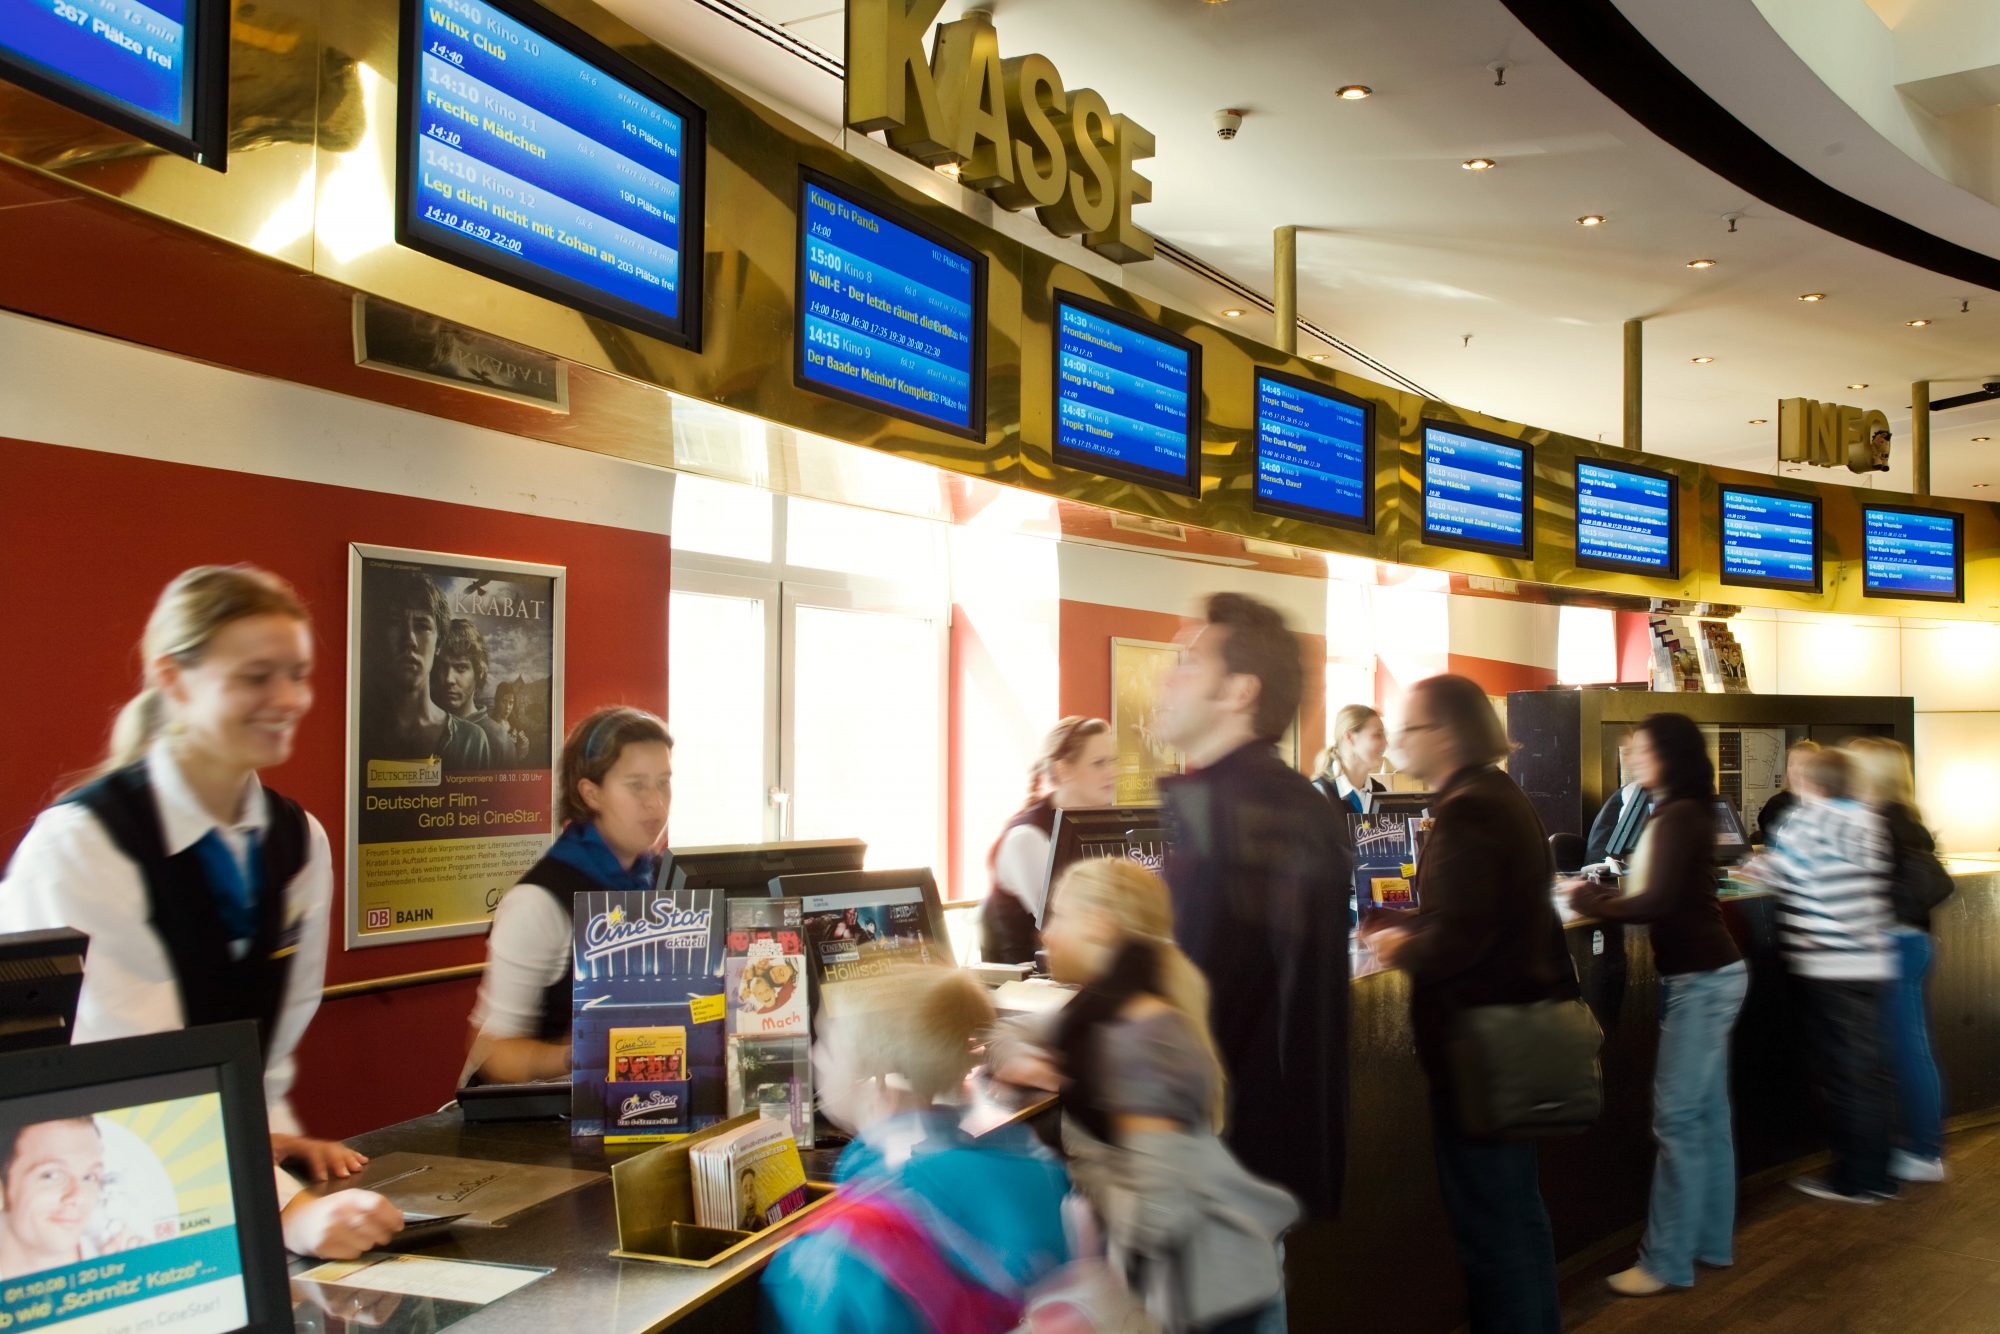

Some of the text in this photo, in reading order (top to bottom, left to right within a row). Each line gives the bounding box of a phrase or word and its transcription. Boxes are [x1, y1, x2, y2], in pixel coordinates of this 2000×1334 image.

[53, 1, 172, 70] 267 Plätze frei
[146, 22, 175, 43] min
[429, 7, 506, 61] Winx Club
[487, 17, 540, 57] Kino 10
[429, 41, 464, 67] 14:40
[428, 67, 538, 133] 14:10 Kino 11
[618, 93, 638, 109] start
[426, 90, 546, 159] Freche Mädchen
[427, 123, 462, 148] 14:10
[847, 0, 1156, 264] KASSE
[621, 119, 678, 158] 143 Plätze frei
[426, 149, 537, 209] 14:10 Kino 12
[424, 172, 616, 265] Leg dich nicht mit Zohan an
[620, 189, 677, 225] 190 Plätze frei
[811, 190, 880, 234] Kung Fu Panda
[424, 205, 523, 254] 14:10 16:50 22:00
[811, 221, 832, 239] 14:00
[617, 258, 675, 292] 203 Plätze frei
[810, 246, 873, 284] 15:00 Kino 8
[809, 269, 840, 294] Wall-E
[848, 285, 865, 303] Der
[866, 291, 892, 314] letzte
[893, 305, 919, 325] räumt
[810, 300, 941, 358] 14:00 15:00 16:30 17:35 19:30 20:00 22:30
[1063, 311, 1088, 329] 14:30
[809, 325, 871, 359] 14:15 Kino 9
[807, 348, 897, 390] Der Baader Meinhof
[1063, 358, 1087, 373] 14:00
[1062, 370, 1115, 395] Kung Fu Panda
[1261, 383, 1281, 397] 14:45
[940, 394, 957, 409] Plätze
[1062, 403, 1086, 419] 14:45
[1087, 410, 1104, 424] Kino
[1261, 394, 1304, 414] Tropic Thunder
[1062, 417, 1114, 439] Tropic Thunder
[1261, 422, 1281, 435] 14:00
[1778, 397, 1891, 474] INFO
[1261, 433, 1307, 453] The Dark Knight
[1261, 461, 1281, 474] 14:00
[1428, 477, 1447, 488] Freche
[1428, 510, 1438, 520] Leg
[1438, 512, 1451, 521] dich
[455, 596, 545, 620] KRABAT
[370, 768, 439, 781] DEUTSCHER FILM
[445, 775, 494, 784] Vorpremiere
[521, 773, 530, 782] 20
[530, 773, 543, 782] Uhr
[366, 792, 478, 810] Deutscher Film
[418, 809, 543, 828] Groß bei CineStar.
[1355, 816, 1405, 841] CineStar
[369, 908, 434, 926] DB BAHN
[586, 898, 712, 949] CineStar
[665, 935, 706, 949] aktuell
[823, 958, 892, 982] Höllisch!
[761, 1011, 801, 1032] Mach
[616, 1036, 657, 1051] CineStar
[622, 1091, 678, 1115] CineStar
[178, 1216, 212, 1232] BAHN
[78, 1262, 126, 1285] 20 Uhr
[15, 1301, 53, 1324] wie
[156, 1297, 222, 1327] CineStar!
